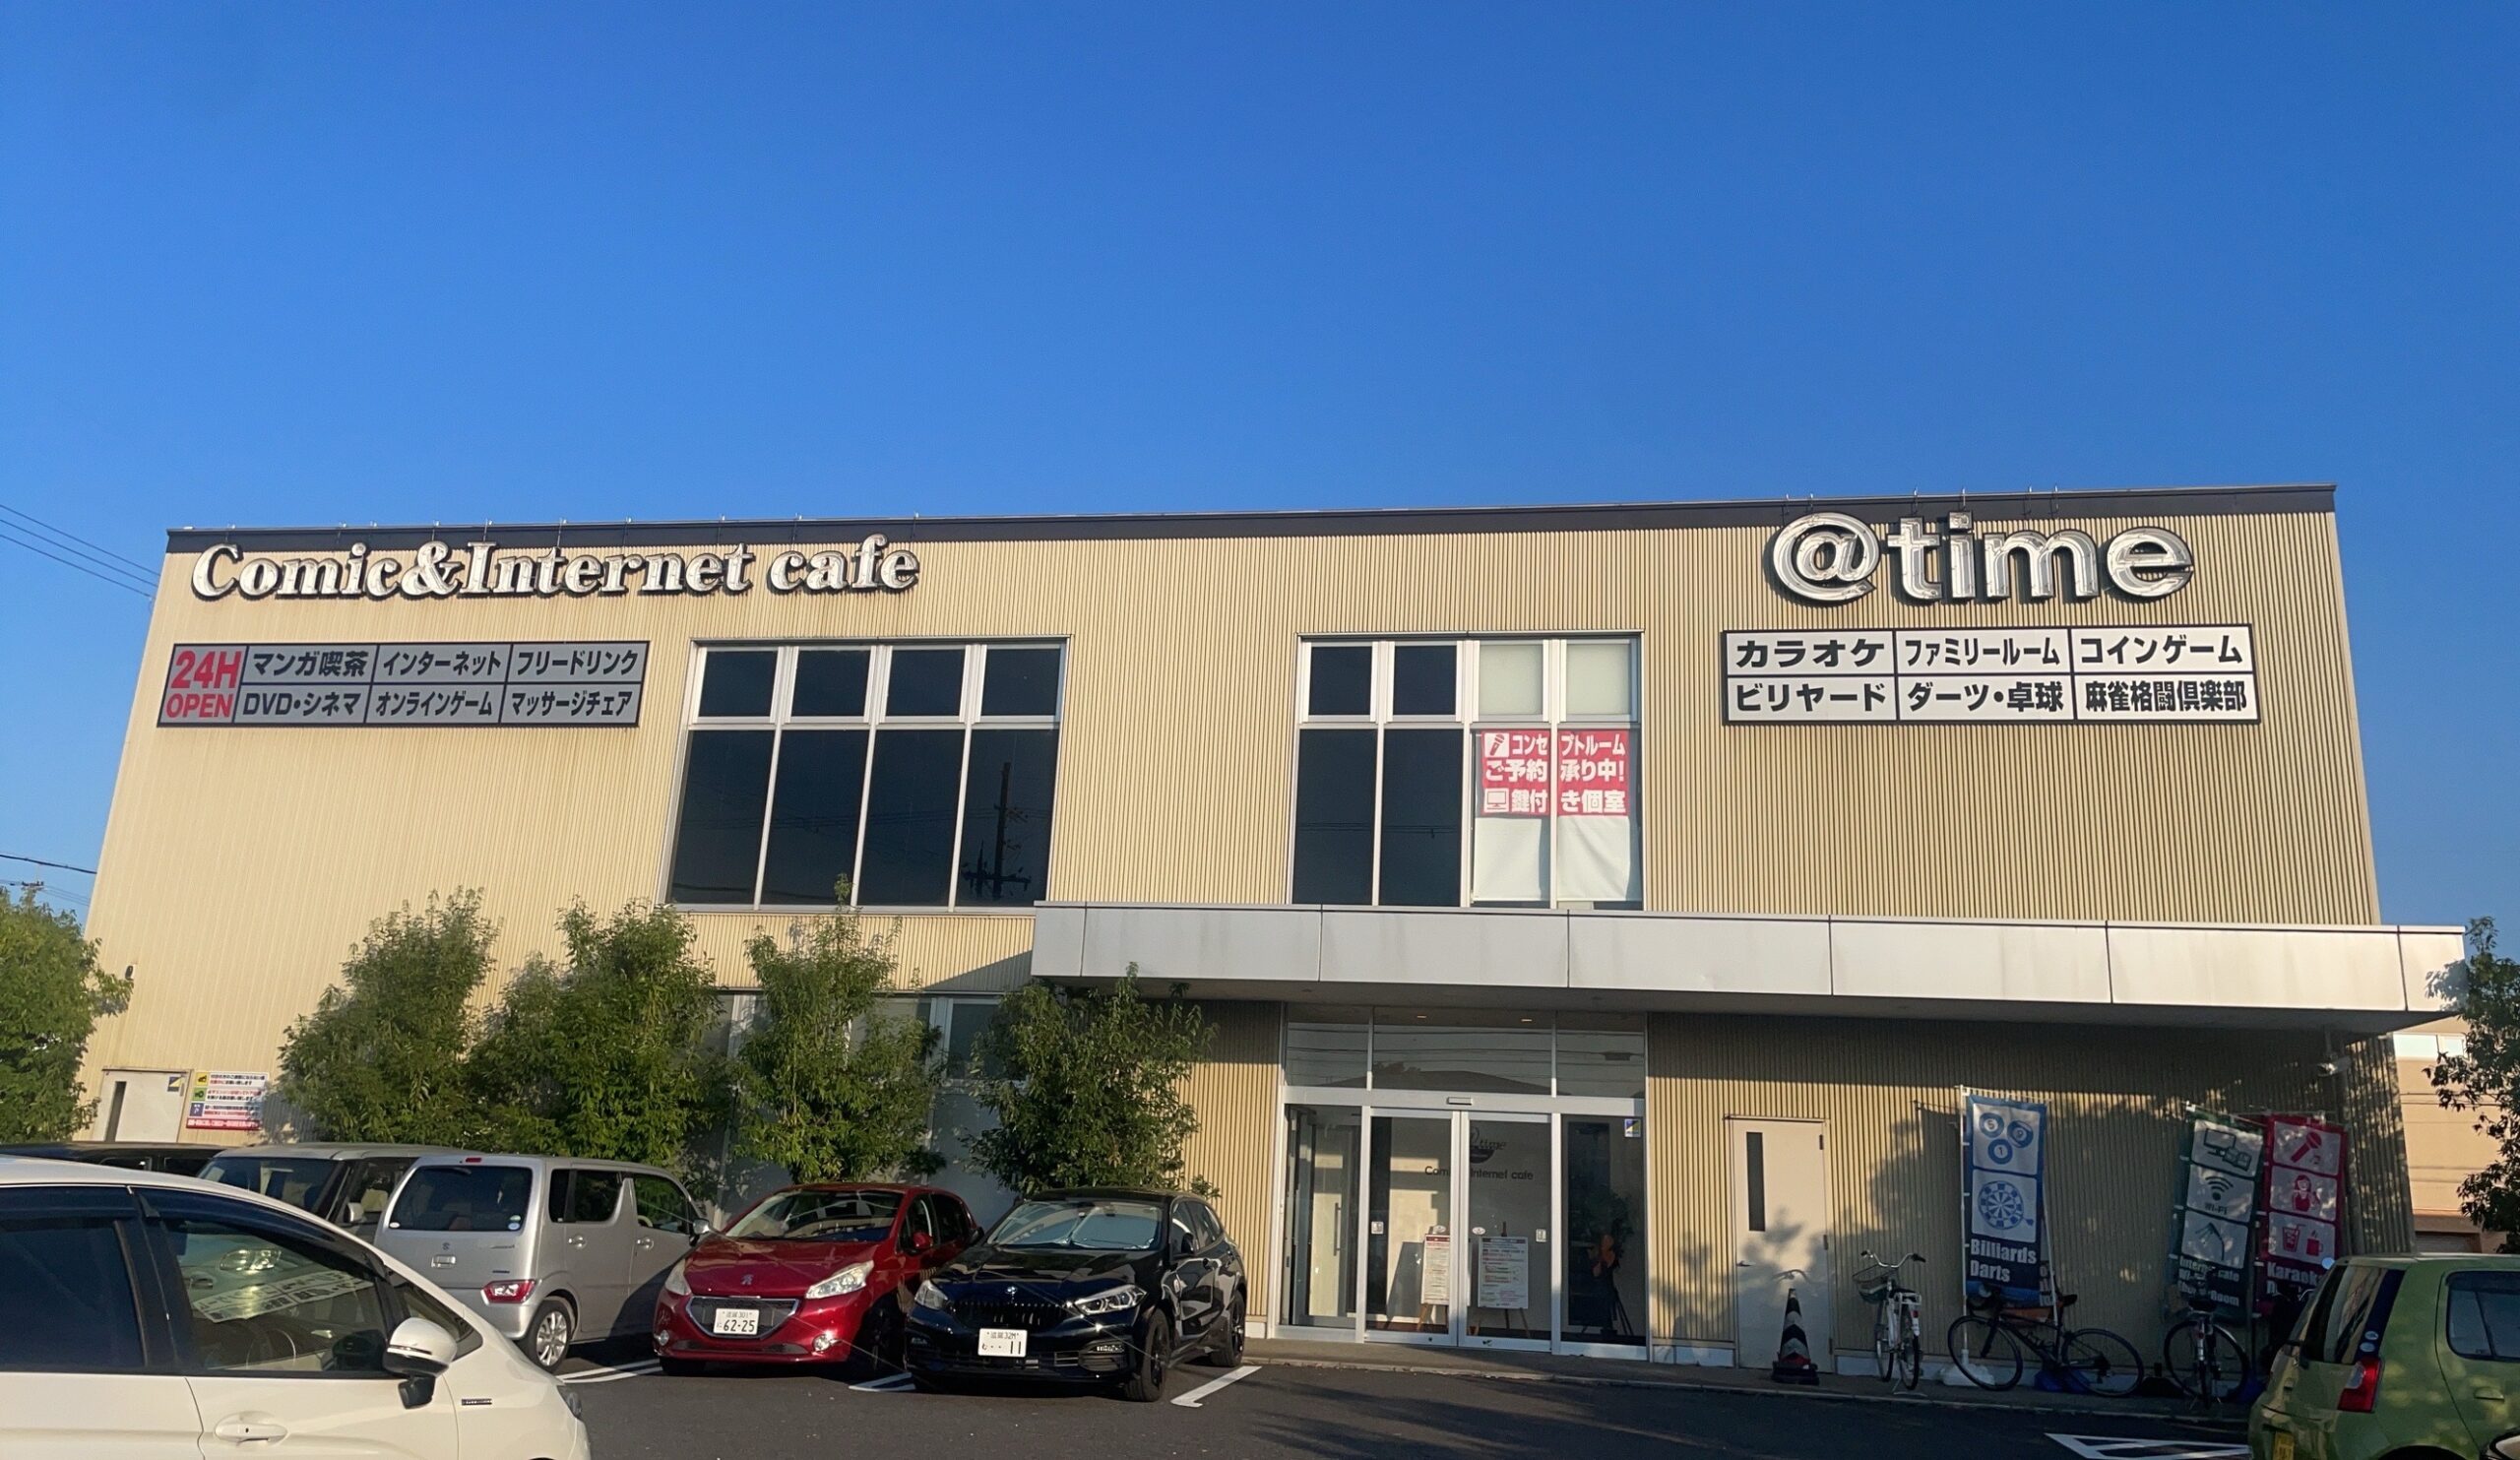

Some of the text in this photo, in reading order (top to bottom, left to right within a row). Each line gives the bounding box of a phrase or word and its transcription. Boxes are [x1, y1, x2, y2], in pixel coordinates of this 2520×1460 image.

[192, 533, 920, 598] Comic&Internet cafe
[1770, 510, 2194, 603] @time
[383, 650, 502, 676] インターネット
[517, 649, 639, 676] フリードリンク
[1735, 638, 1885, 668] カラオケ
[1904, 636, 2061, 667] ファミリールーム
[2079, 632, 2243, 667] コインゲーム
[170, 650, 242, 689] 24H
[253, 650, 369, 677] マンガ喫茶
[165, 692, 234, 719] OPEN
[242, 691, 362, 717] DVD・シネマ
[376, 690, 493, 717] オンラインゲーム
[511, 690, 633, 717] マッサージチェア
[1736, 682, 1886, 712] ビリヤード
[1908, 680, 2064, 712] ダーツ・卓球
[2085, 679, 2247, 713] 麻雀格闘倶楽部
[1970, 1238, 2037, 1265] Billiards
[1970, 1259, 2010, 1283] Darts
[724, 1319, 755, 1333] 62-25
